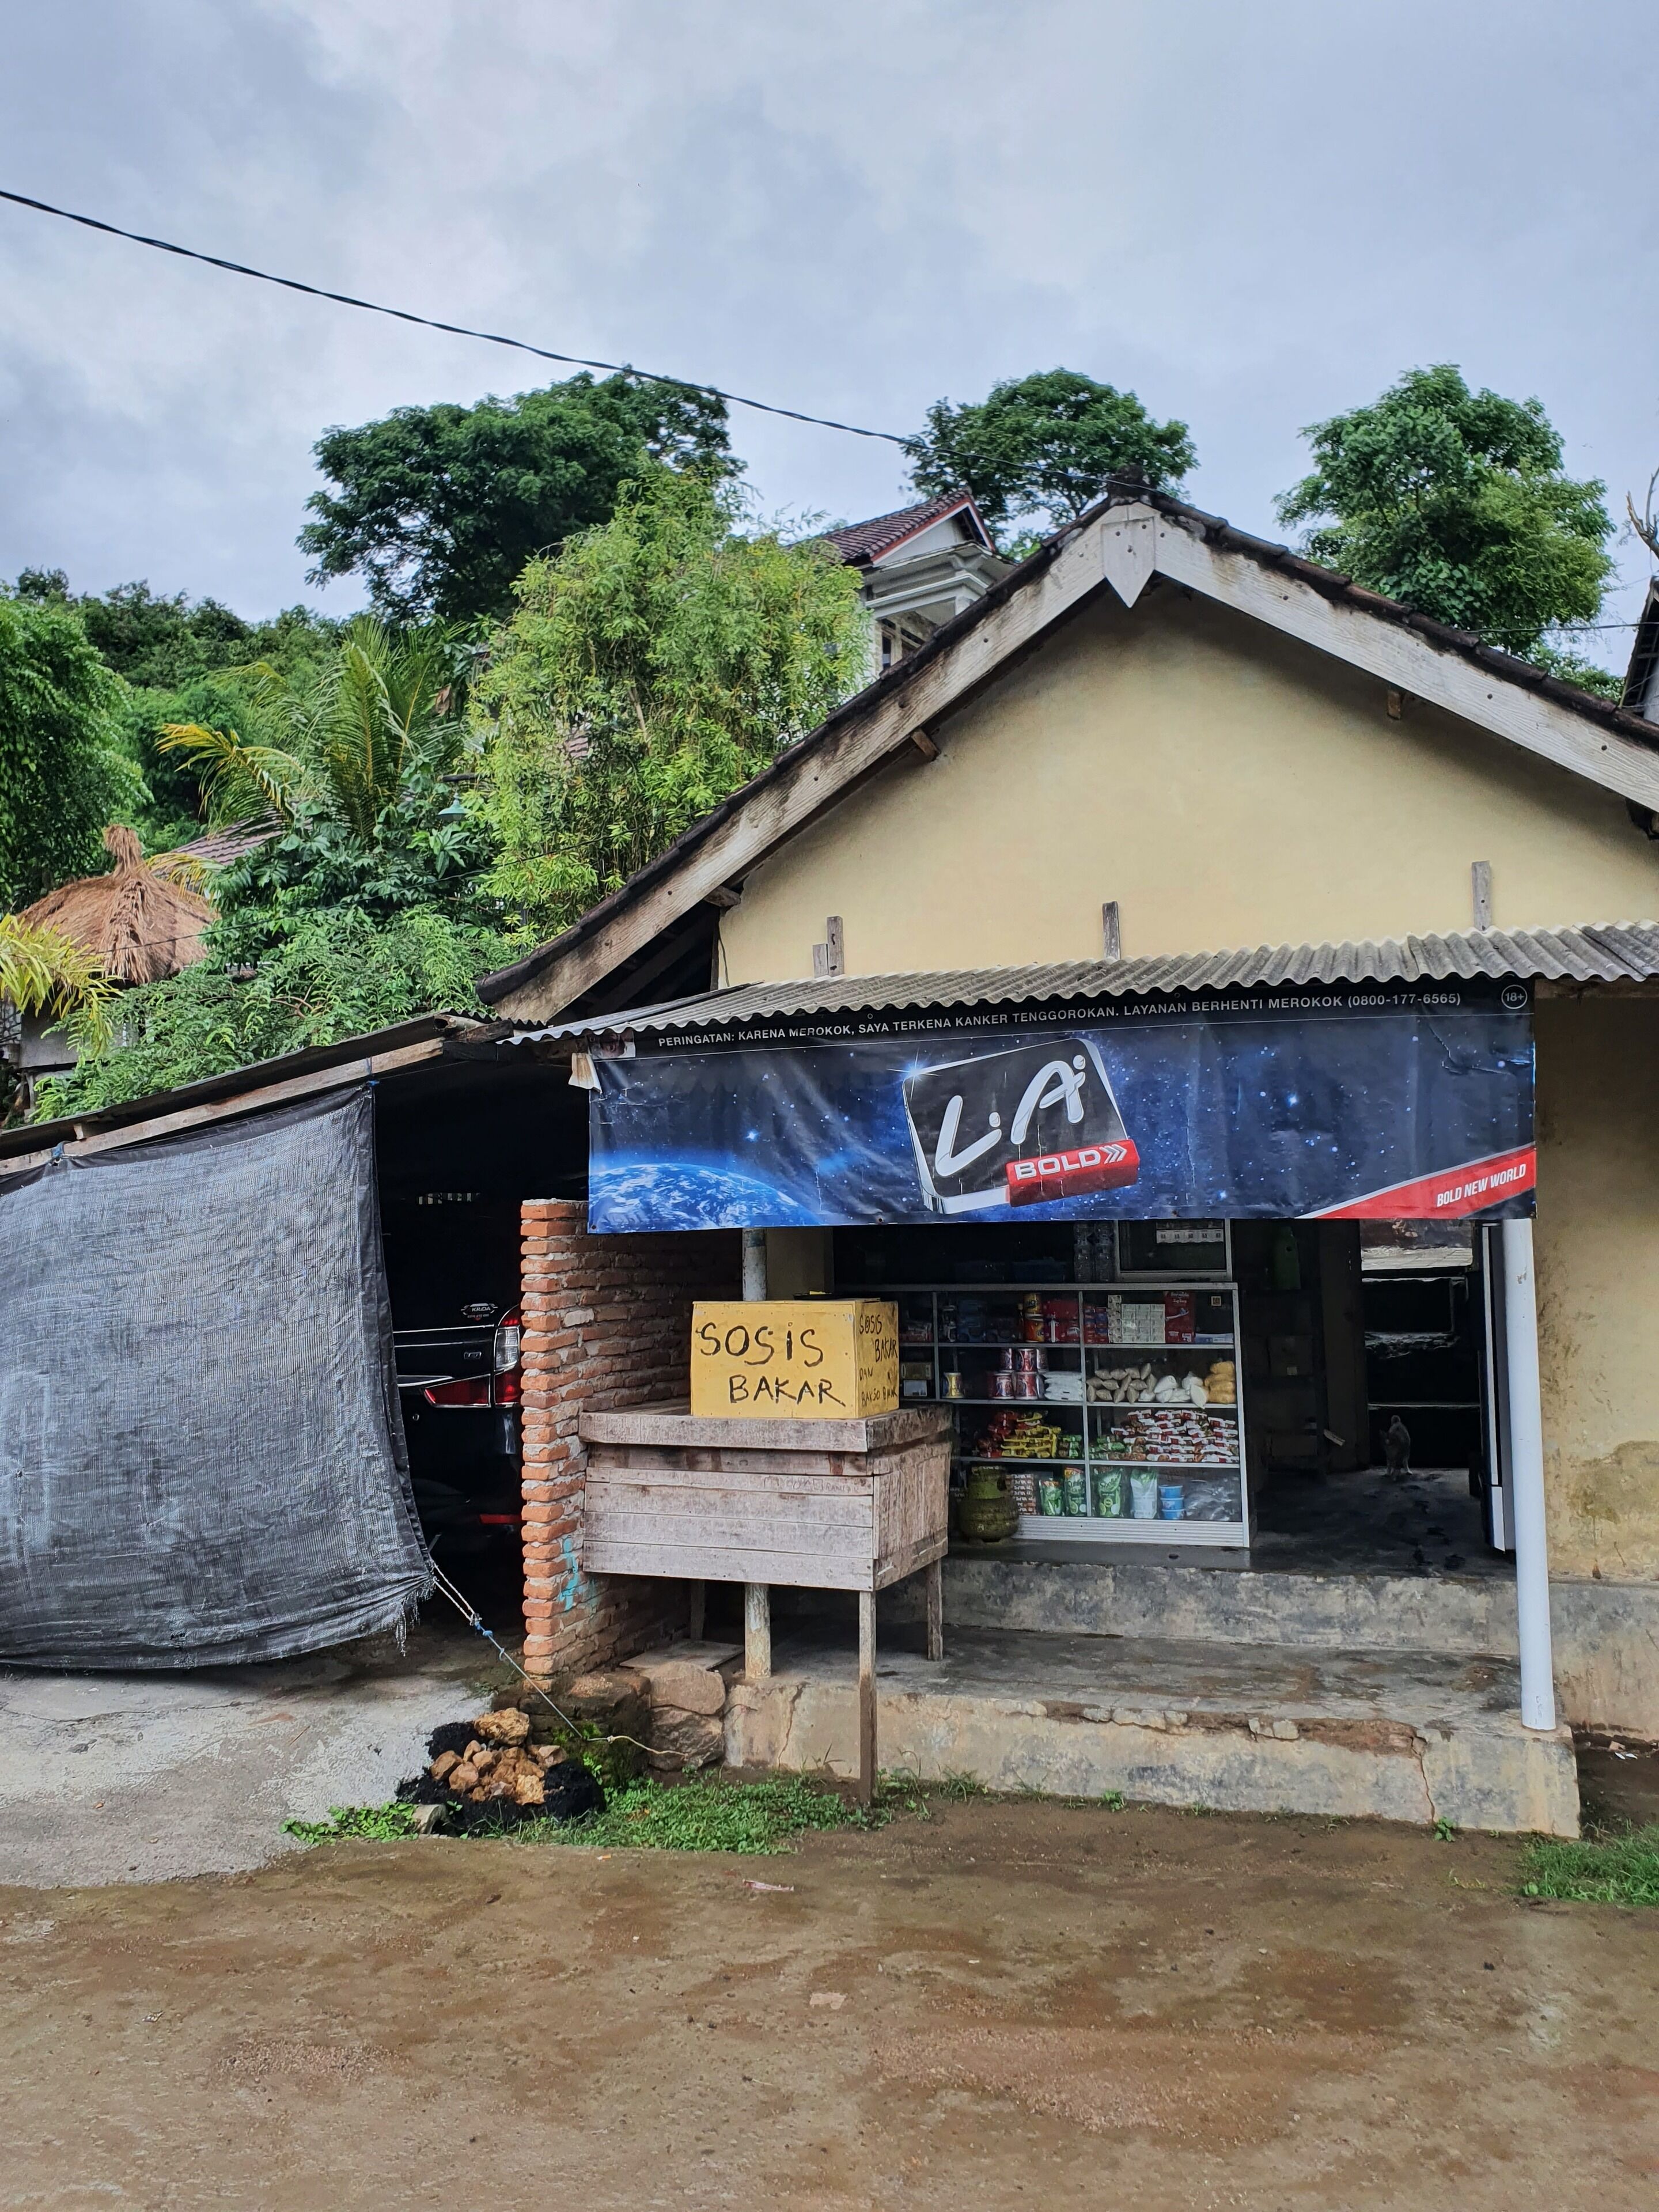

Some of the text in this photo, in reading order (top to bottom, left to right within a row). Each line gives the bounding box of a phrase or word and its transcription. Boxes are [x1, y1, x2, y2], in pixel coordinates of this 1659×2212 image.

[1505, 993, 1525, 1002] 18+
[658, 993, 1461, 1047] PERINGATAN: KARENA MEROKOK, SAYA TERKENA KANKER TENGGOROKAN. LAYANAN BERHENTI MEROKOK (0800-177-6565)
[1014, 1150, 1101, 1180] BOLD
[1437, 1164, 1527, 1207] BOLD NEW WORLD
[859, 1314, 882, 1335] SOSIS
[874, 1336, 898, 1363] BAKAR
[859, 1367, 873, 1381] DAN
[729, 1374, 846, 1407] BAKAR
